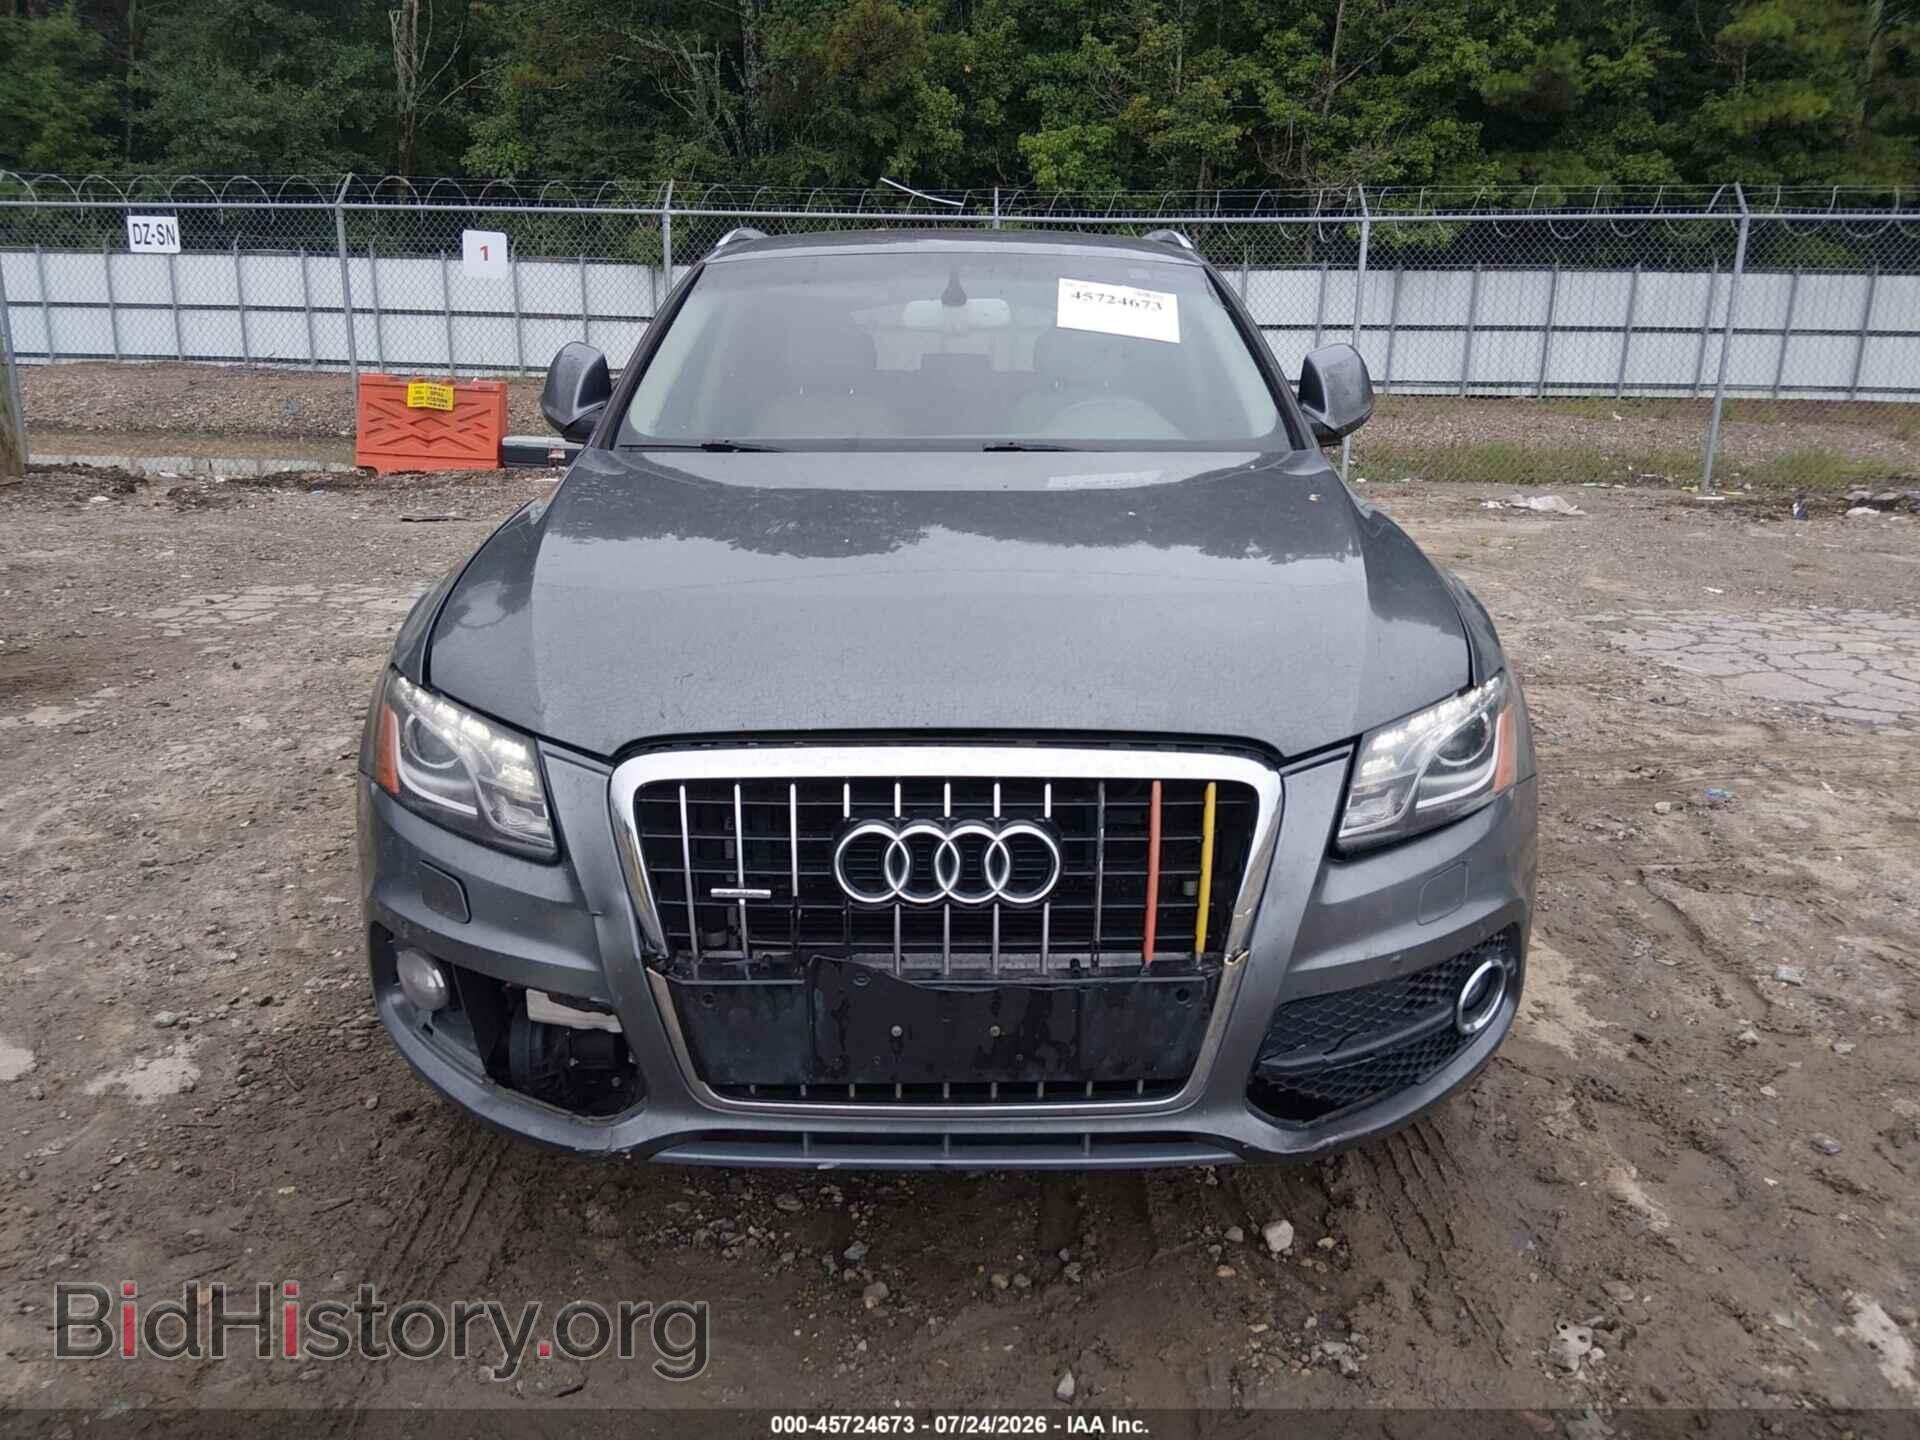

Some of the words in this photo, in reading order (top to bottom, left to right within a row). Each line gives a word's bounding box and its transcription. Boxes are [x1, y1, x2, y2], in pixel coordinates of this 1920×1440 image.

[133, 223, 176, 246] DZ-SN
[480, 245, 488, 261] 1
[1071, 290, 1163, 312] 45724673
